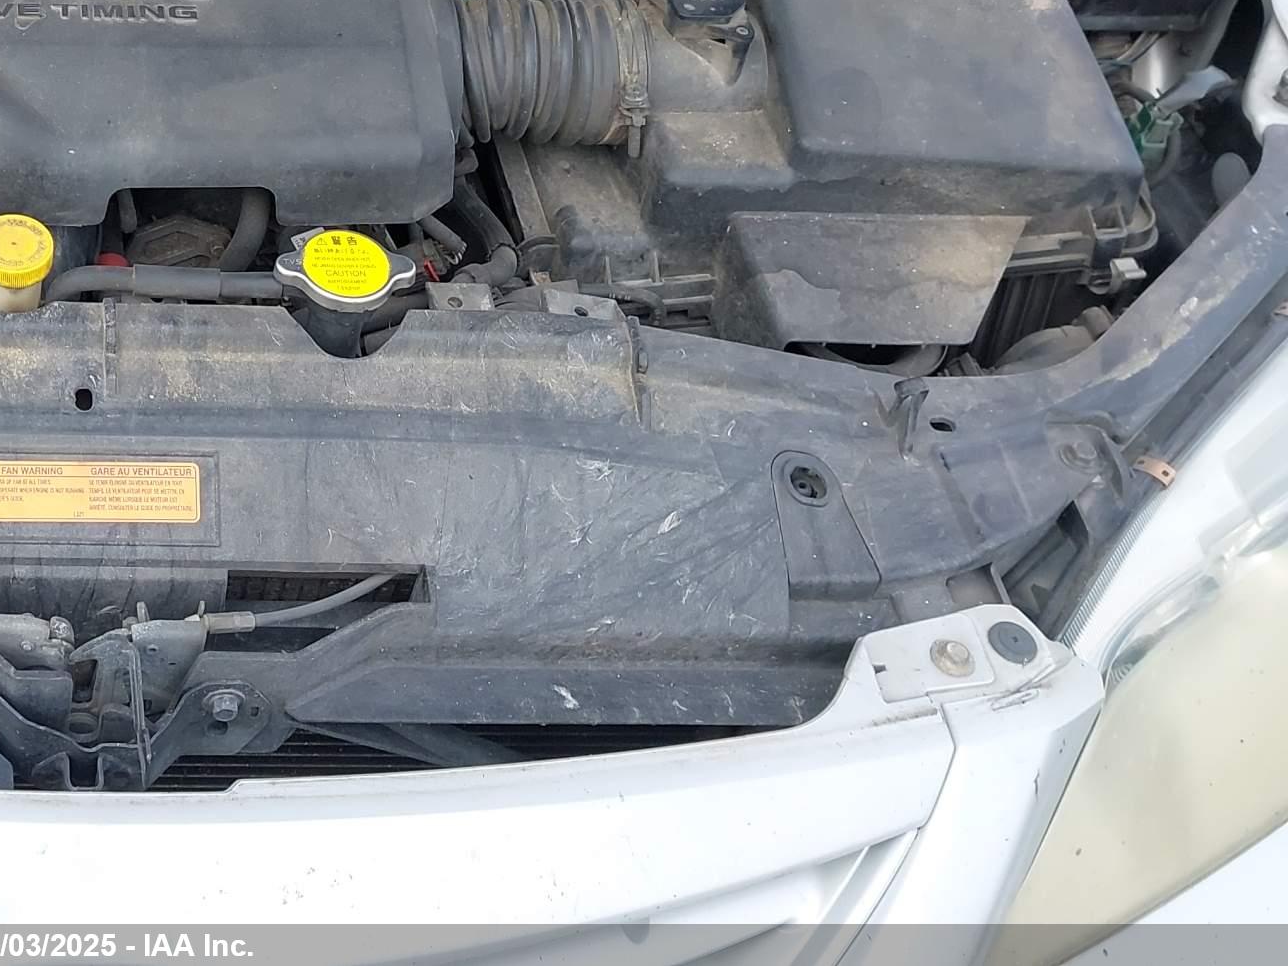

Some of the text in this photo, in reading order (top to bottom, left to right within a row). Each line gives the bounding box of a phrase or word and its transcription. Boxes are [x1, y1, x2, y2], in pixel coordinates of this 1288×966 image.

[51, 4, 199, 23] TIMING
[1, 466, 63, 475] FAN WARNING
[90, 468, 192, 476] GARE AU VENTILATEUR
